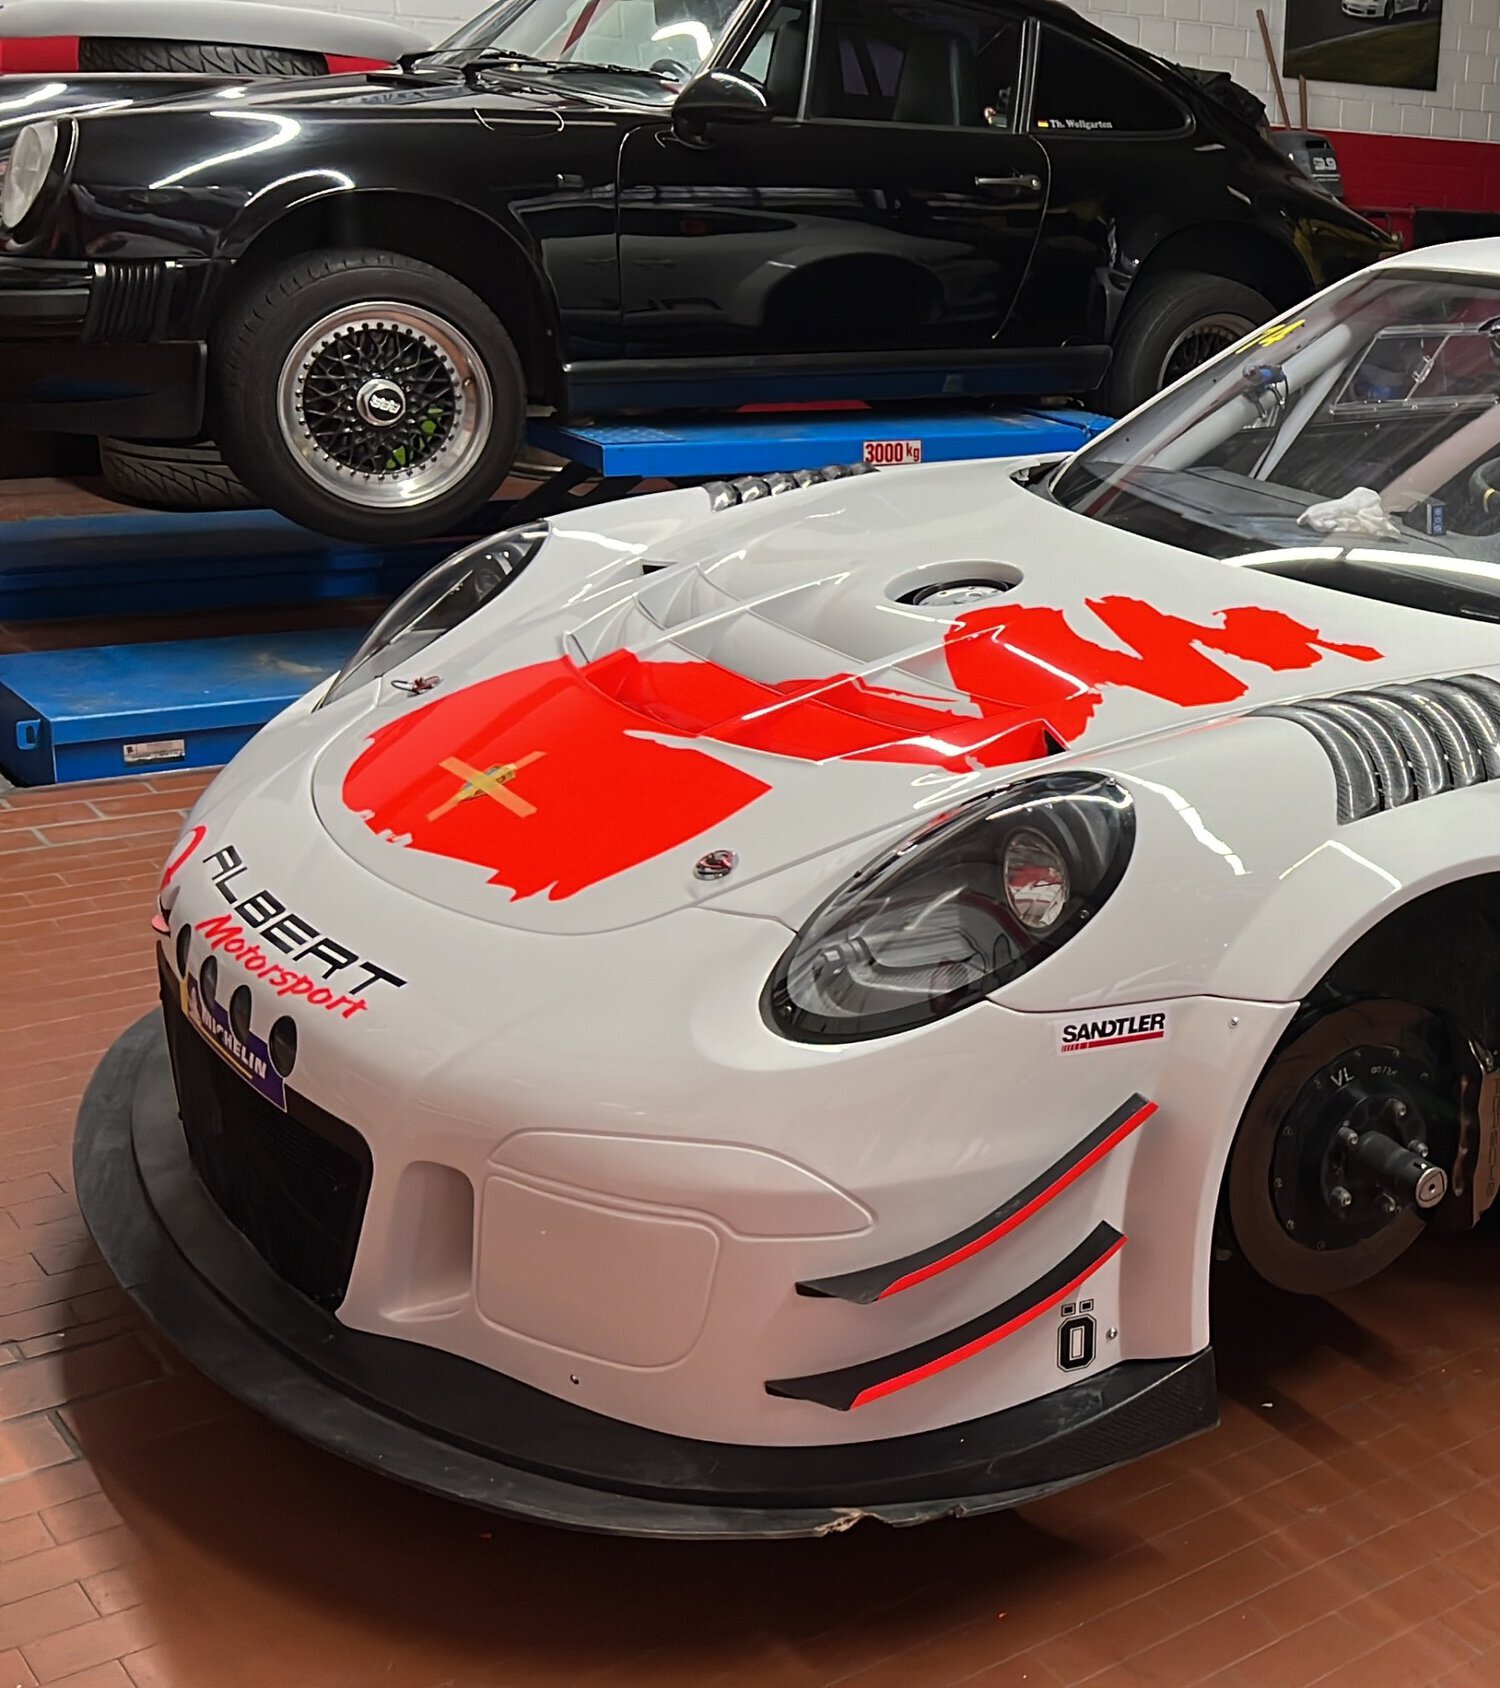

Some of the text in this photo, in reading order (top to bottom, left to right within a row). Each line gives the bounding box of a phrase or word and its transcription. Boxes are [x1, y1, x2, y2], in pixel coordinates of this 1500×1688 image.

[865, 442, 920, 463] 3000 kg
[202, 845, 408, 995] ALBERT
[194, 914, 368, 1019] Motorsport
[1062, 1013, 1166, 1043] SANDTLER
[1330, 1067, 1355, 1087] VL
